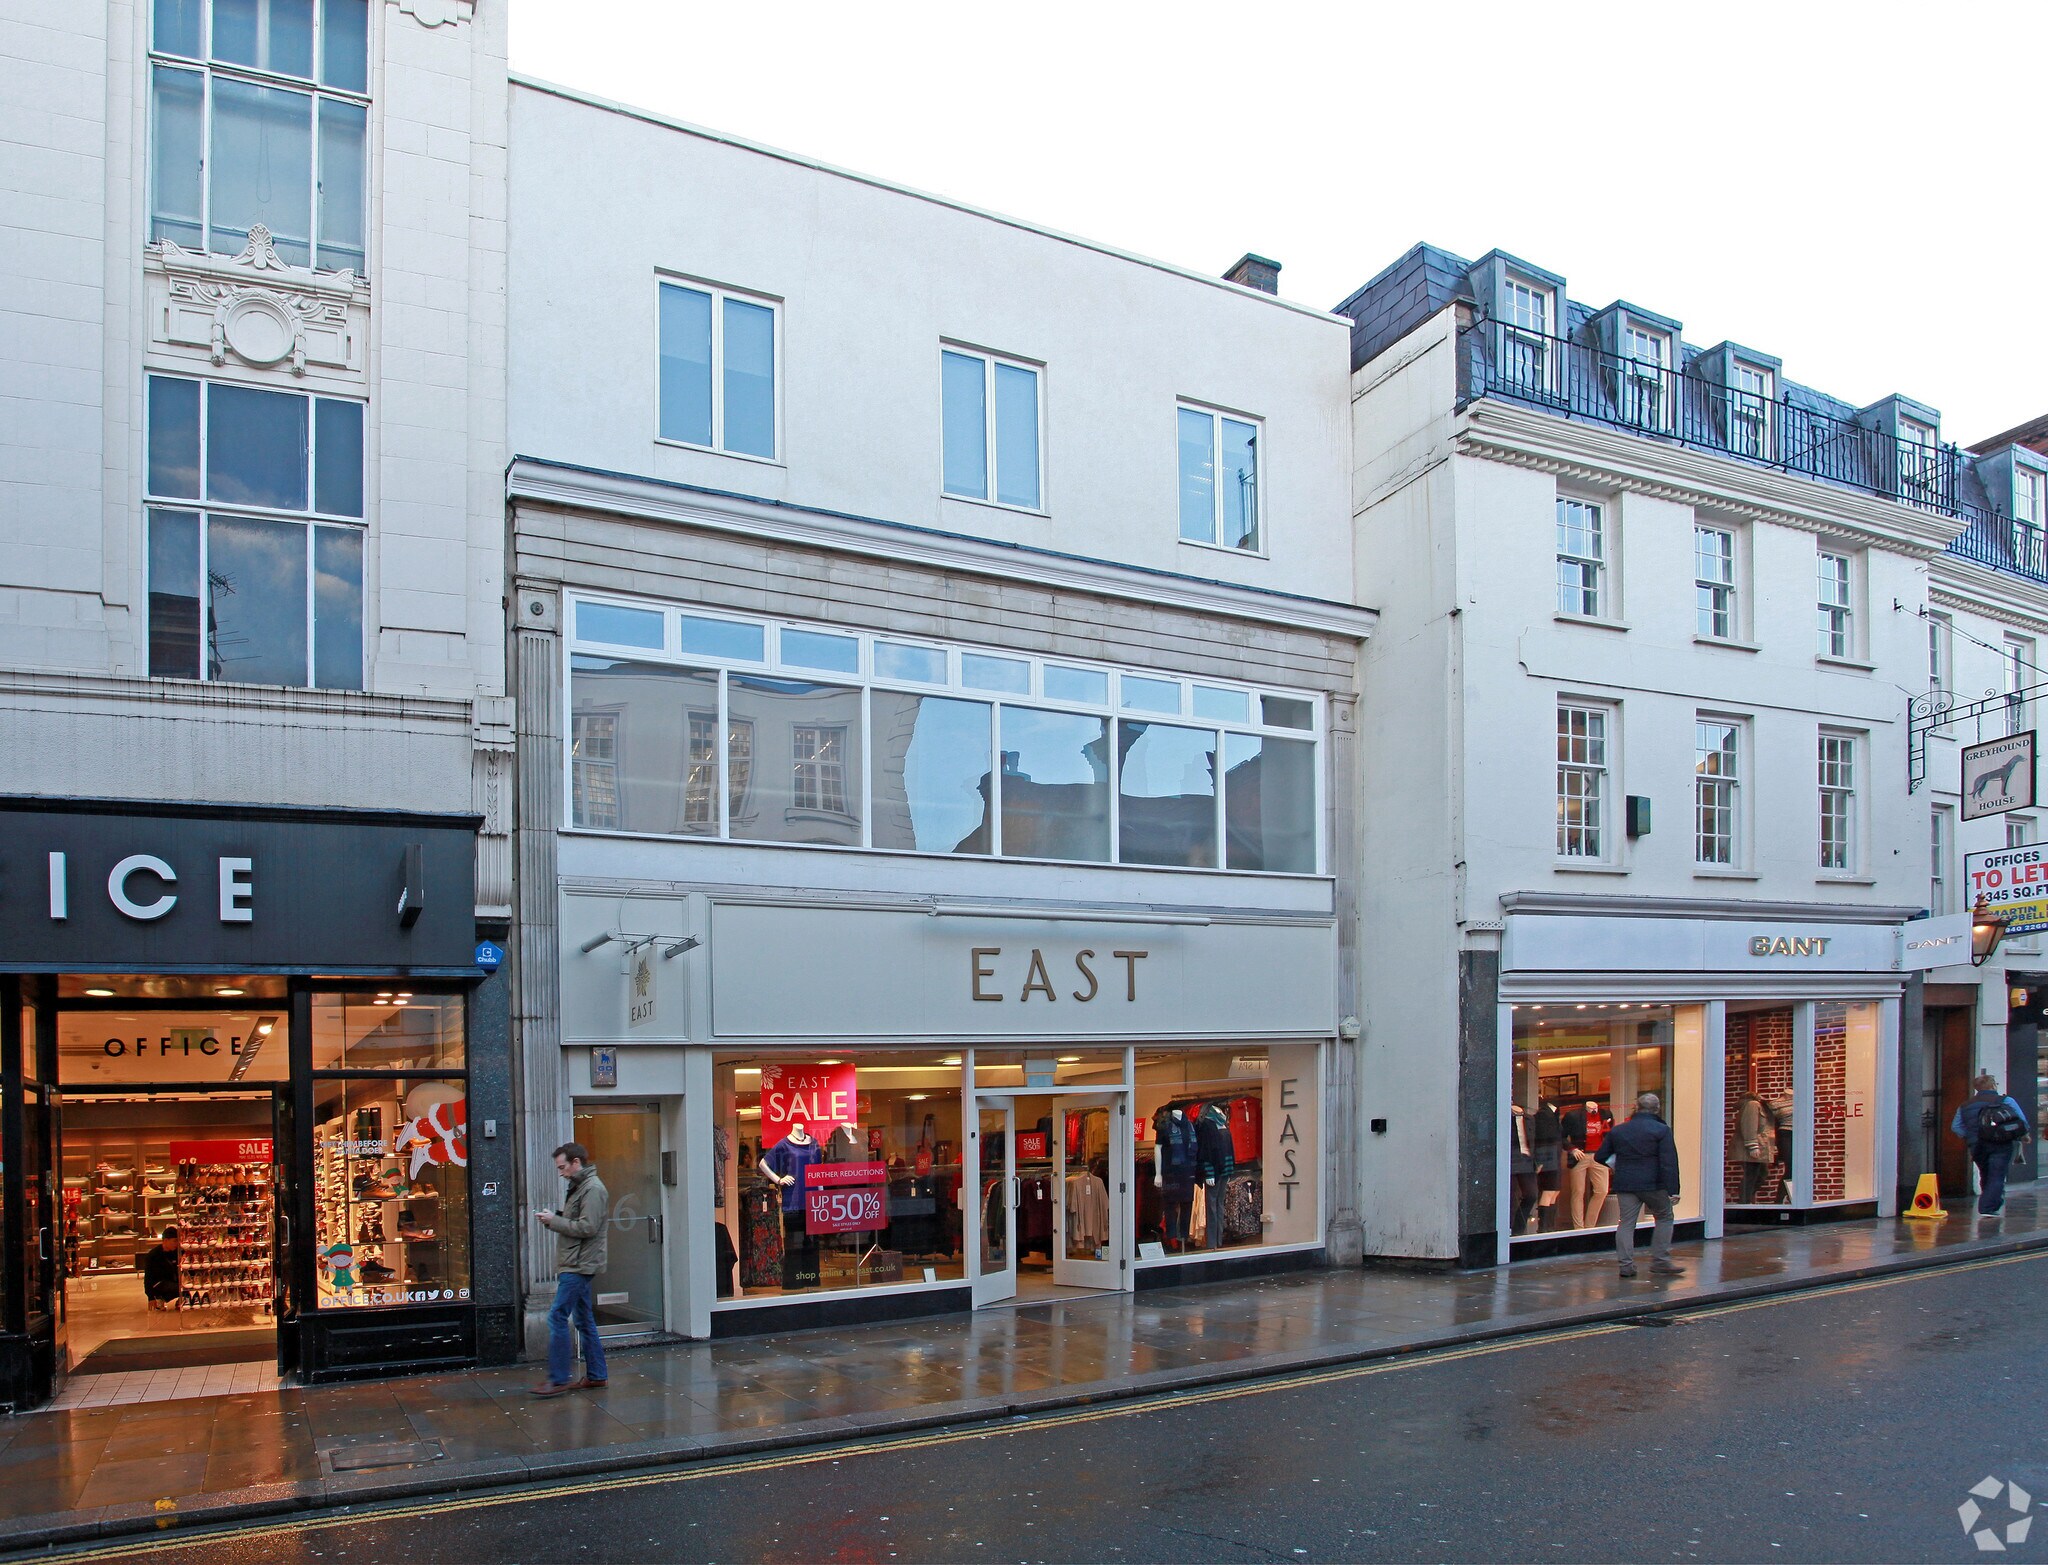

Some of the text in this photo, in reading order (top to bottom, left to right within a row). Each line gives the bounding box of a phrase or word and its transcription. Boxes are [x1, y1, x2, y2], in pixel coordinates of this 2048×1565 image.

[1966, 739, 2030, 761] GREYHOUND
[1979, 796, 2016, 810] HOUSE
[1984, 851, 2040, 868] OFFICES
[1972, 862, 2048, 889] TO LET
[1749, 935, 1831, 956] GANT
[1906, 935, 1963, 950] GANT
[972, 948, 1148, 1001] EAST
[631, 1000, 653, 1021] EAST
[104, 1036, 242, 1057] OFFICE
[788, 1076, 830, 1089] EAST
[769, 1091, 848, 1122] SALE
[239, 1143, 270, 1154] SALE
[358, 1139, 388, 1147] BEFORE
[1023, 1137, 1041, 1145] SALE
[1278, 1078, 1300, 1210] EAST
[807, 1168, 884, 1179] FURTHER REDUCTIONS
[811, 1195, 830, 1209] UP
[831, 1192, 880, 1221] 50%
[811, 1208, 830, 1222] TO
[864, 1210, 880, 1219] OFF
[795, 1271, 816, 1281] shop
[819, 1268, 844, 1277] online
[320, 1291, 414, 1307] OFFICE.CO.UK
